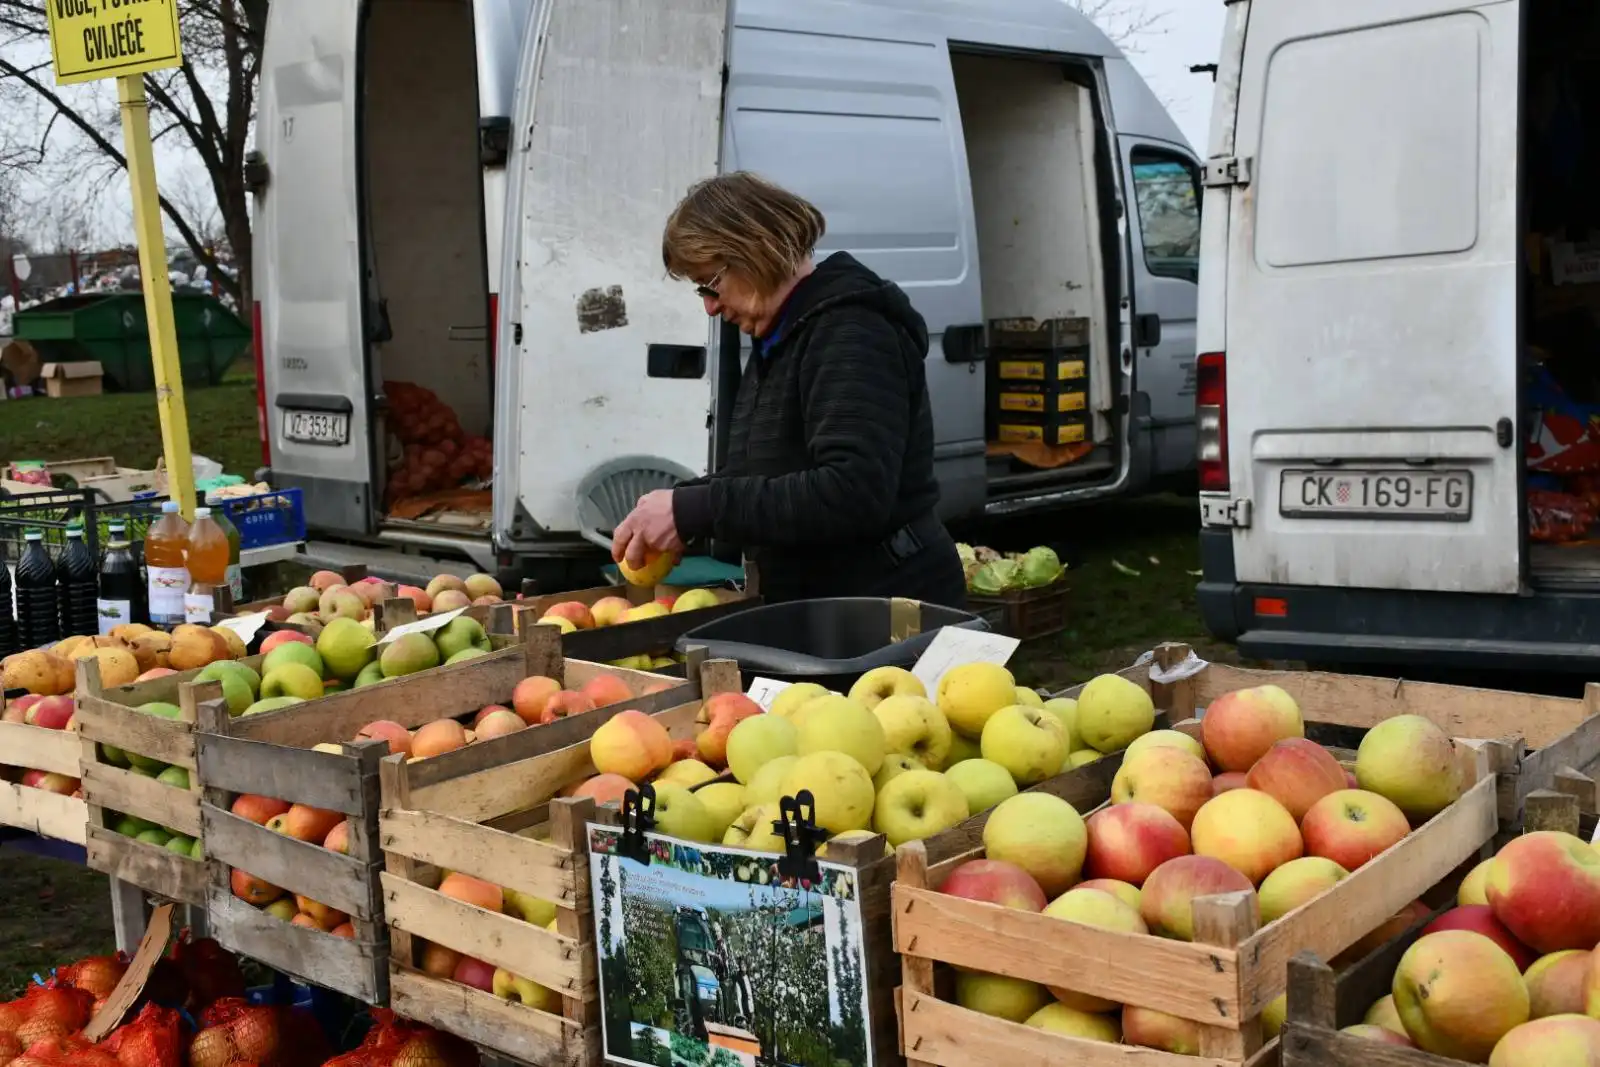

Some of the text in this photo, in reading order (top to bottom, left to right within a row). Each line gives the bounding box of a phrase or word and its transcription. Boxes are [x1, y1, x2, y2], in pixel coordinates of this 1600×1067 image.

[83, 13, 145, 62] CVIJEĆE
[291, 413, 344, 438] VZ 353-KL
[1302, 476, 1463, 508] CK 169-FG
